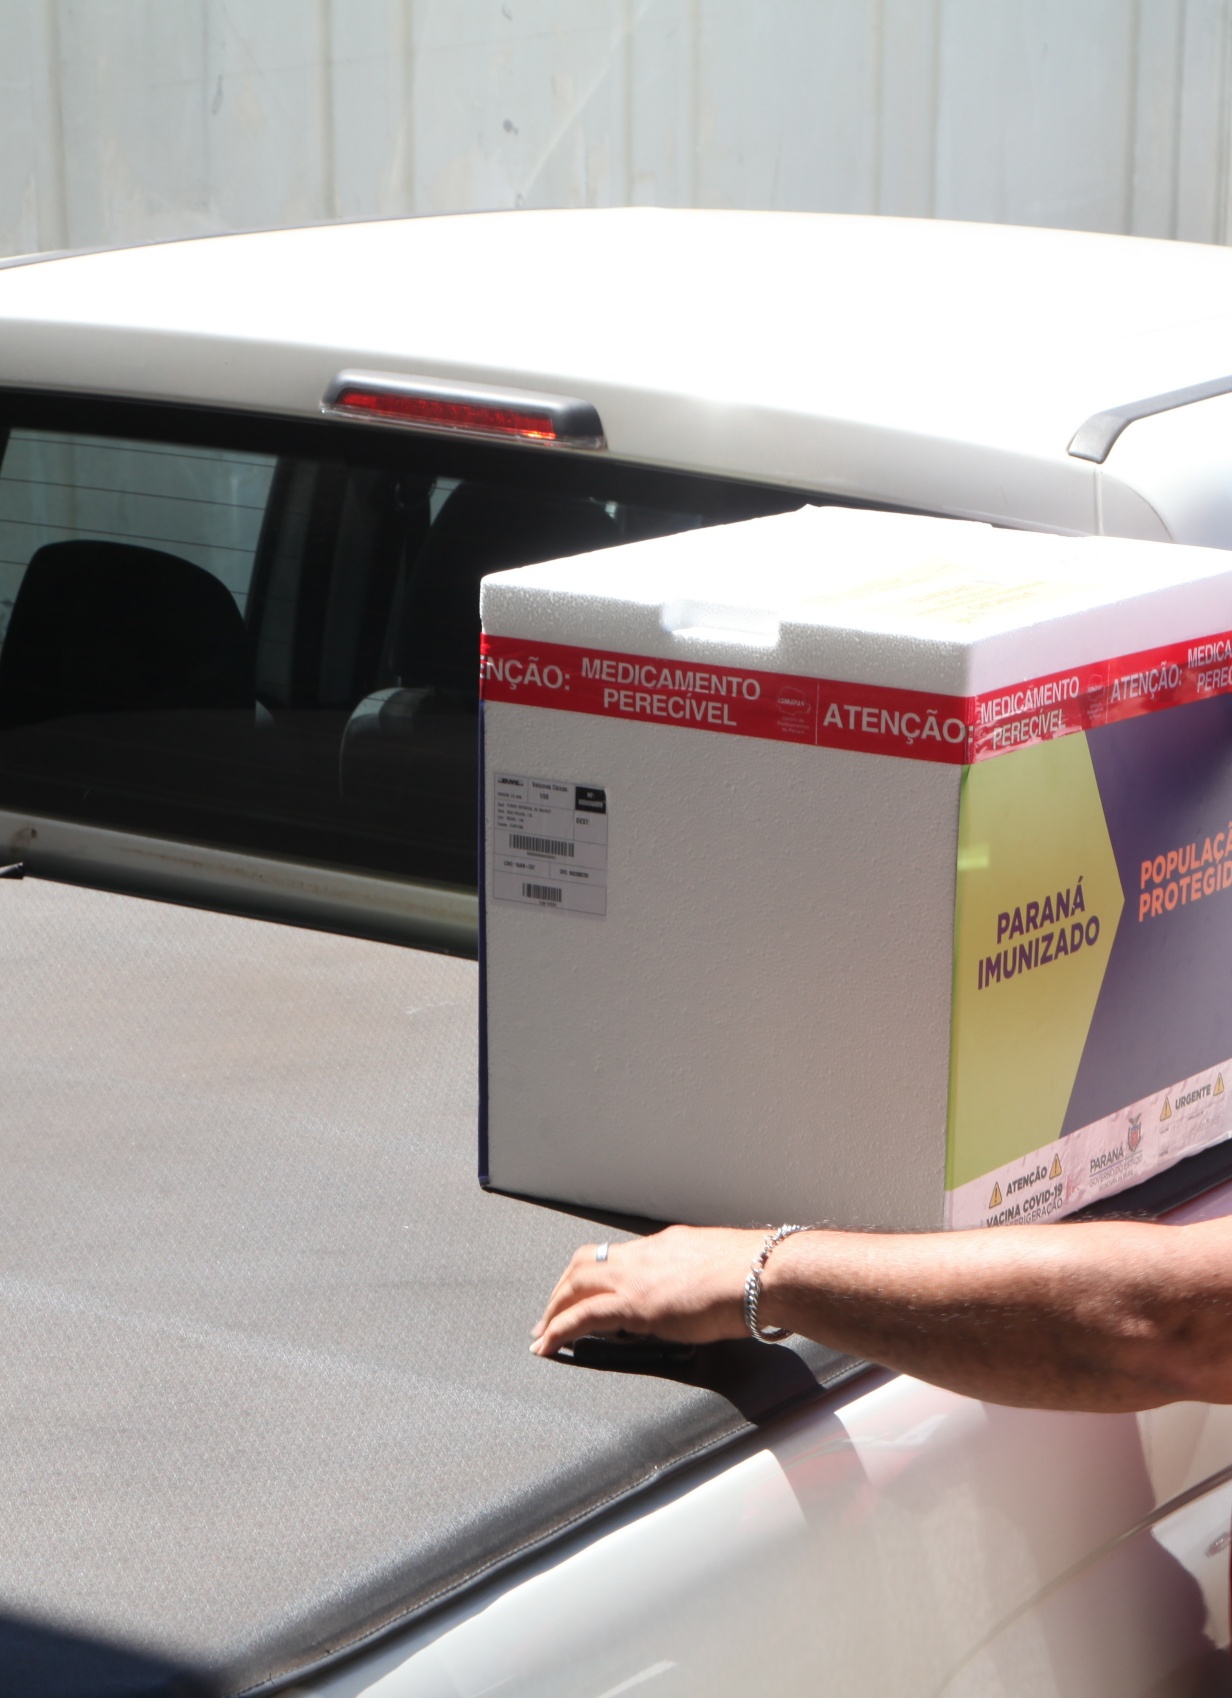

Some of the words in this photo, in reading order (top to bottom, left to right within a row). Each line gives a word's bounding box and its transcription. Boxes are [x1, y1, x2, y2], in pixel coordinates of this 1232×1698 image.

[581, 657, 761, 701] MEDICAMENTO
[980, 676, 1080, 725] MEDICAMENTO
[1110, 661, 1184, 704] ATENÇÃO:
[603, 692, 737, 726] PERECÍVEL
[822, 702, 975, 745] ATENÇÃO:
[993, 708, 1066, 750] PERECÍVEL
[997, 875, 1086, 945] PARANÁ
[978, 915, 1100, 991] IMUNIZADO
[1175, 1083, 1212, 1111] URGENTE
[1089, 1142, 1124, 1174] PARANÁ
[1006, 1165, 1048, 1197] ATENÇÃO
[987, 1203, 1021, 1228] VACINA
[1022, 1182, 1063, 1213] COVID-19
